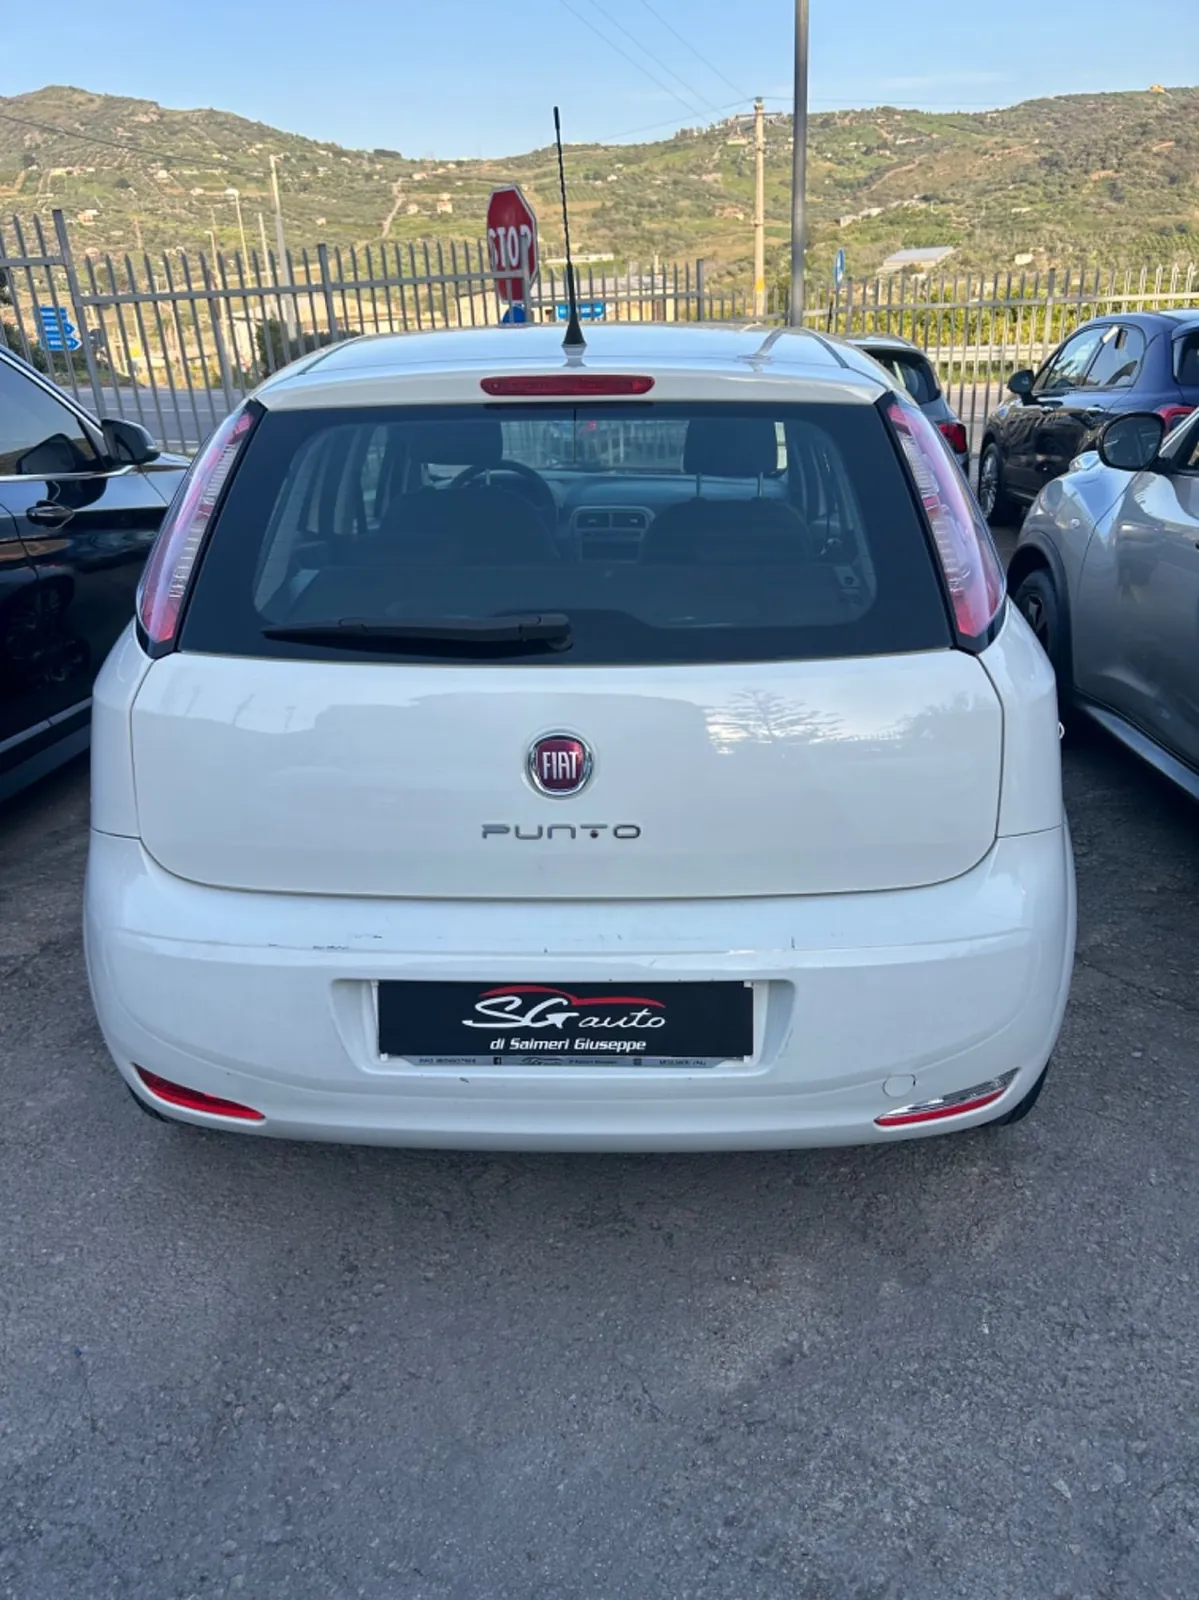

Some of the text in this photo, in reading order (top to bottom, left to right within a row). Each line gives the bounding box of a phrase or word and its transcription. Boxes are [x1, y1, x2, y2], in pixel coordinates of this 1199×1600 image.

[542, 751, 580, 781] FIAT
[481, 823, 642, 841] PUNTO
[489, 1037, 506, 1051] di
[573, 1036, 648, 1054] Giuseppe
